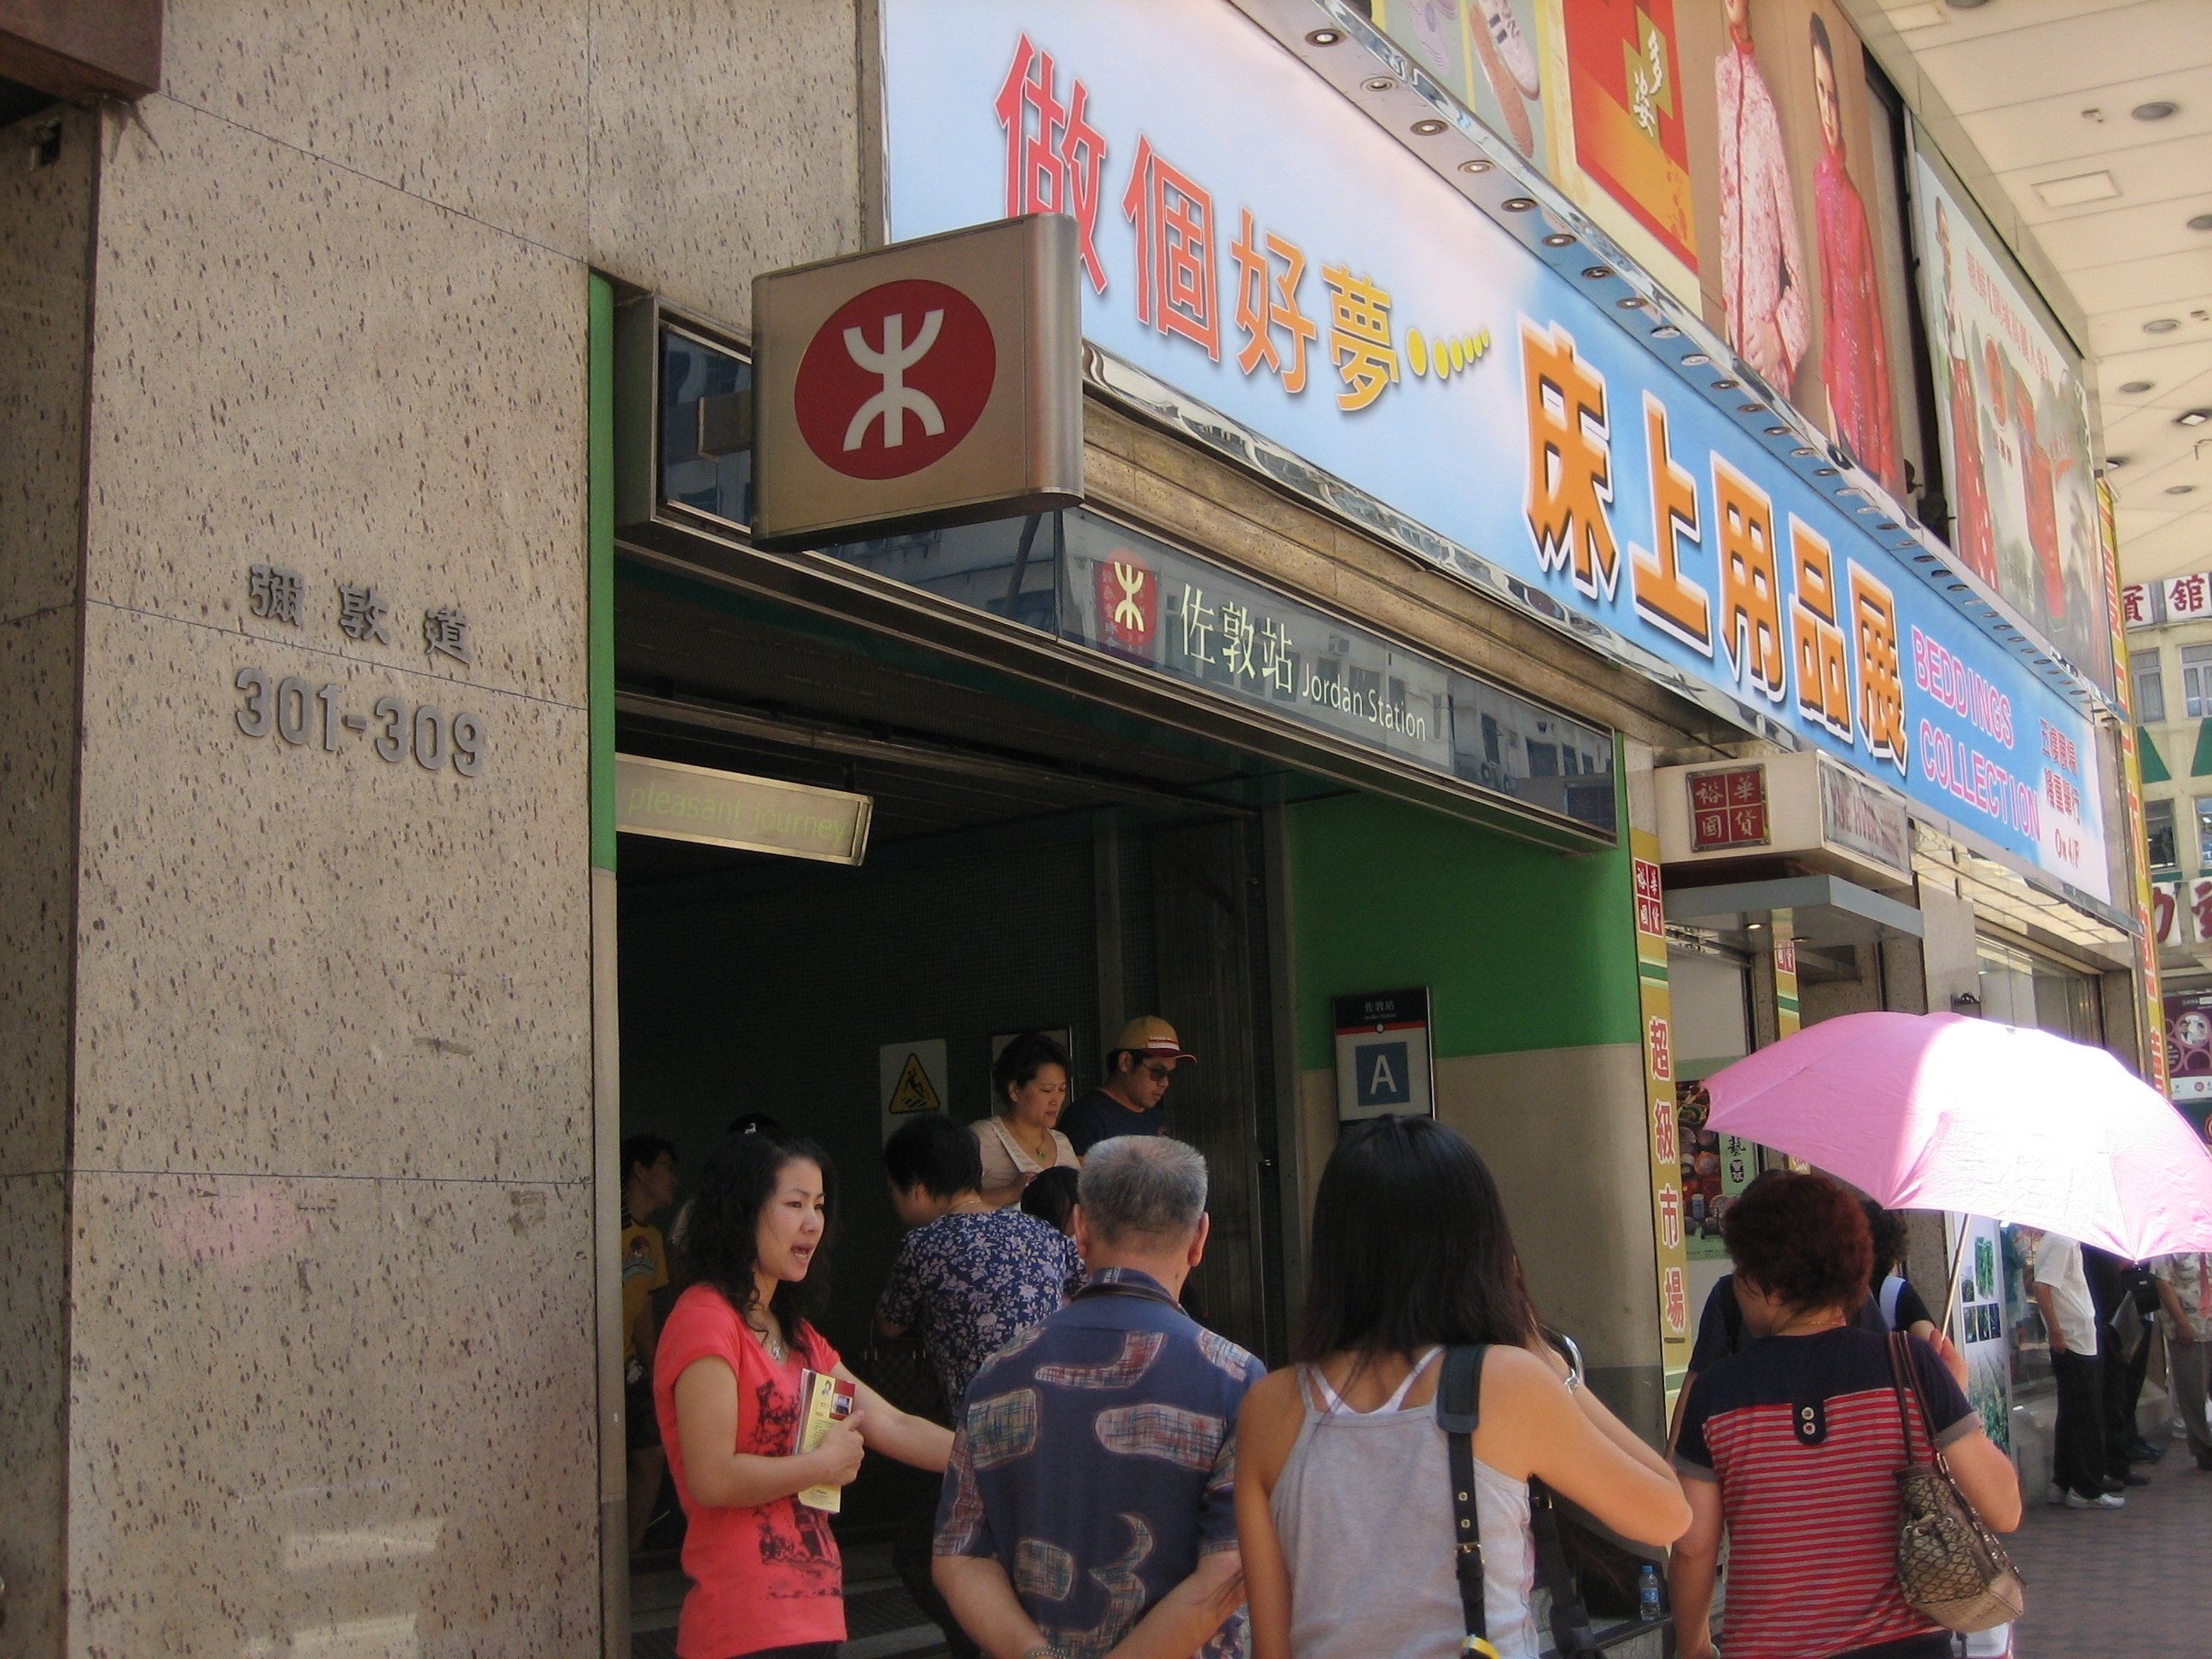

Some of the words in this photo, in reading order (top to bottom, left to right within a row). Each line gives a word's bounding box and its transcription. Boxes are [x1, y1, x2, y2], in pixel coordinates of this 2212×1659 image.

[1517, 312, 1910, 777] 床上用品展
[249, 563, 471, 667] 彌敦道
[1180, 583, 1293, 694] 佐敦站
[234, 667, 486, 777] 301-309
[1301, 662, 1364, 718] Jordan
[1367, 688, 1427, 742] Station
[1911, 624, 2014, 750] BEDDINGS
[627, 781, 744, 828] pleasant
[749, 800, 850, 848] journey
[1920, 718, 2041, 842] COLLECTION
[1370, 1054, 1398, 1094] A
[1649, 1015, 1686, 1333] 超級市場
